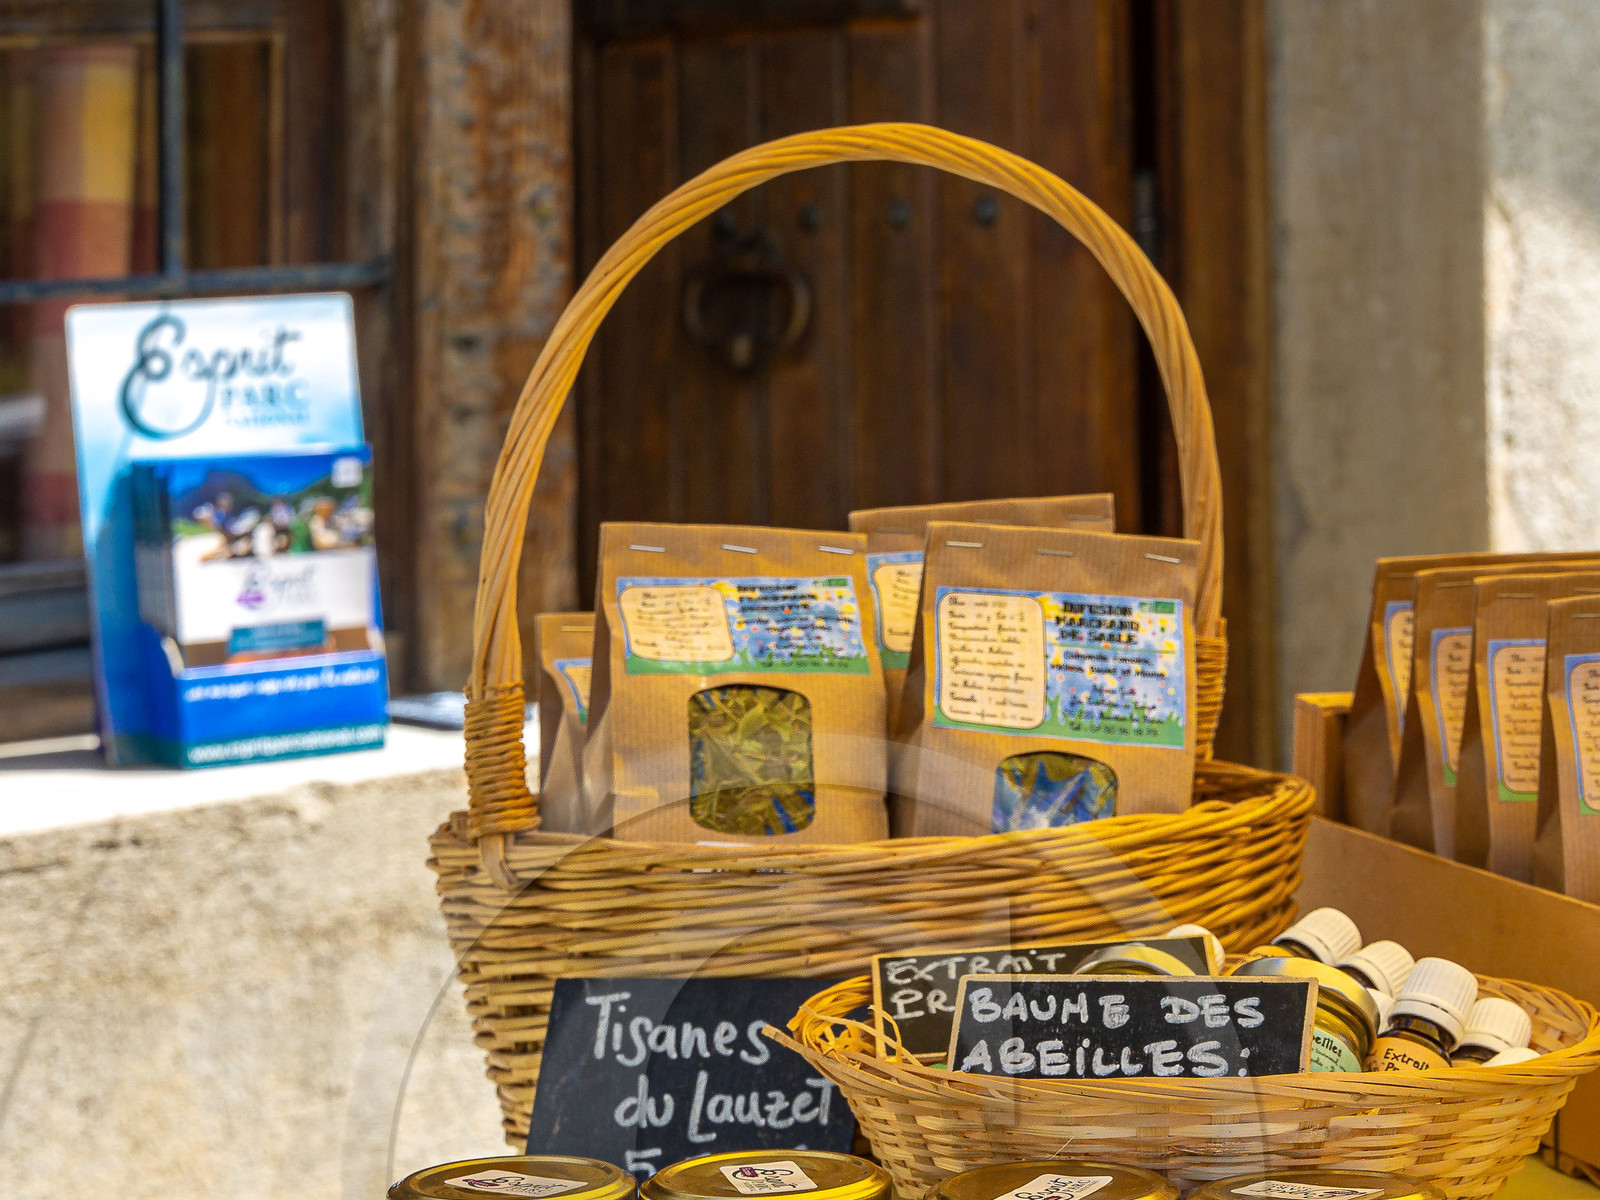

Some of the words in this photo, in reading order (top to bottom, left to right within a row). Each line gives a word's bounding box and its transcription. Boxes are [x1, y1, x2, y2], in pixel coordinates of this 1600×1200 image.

[117, 313, 302, 439] Esprit
[968, 987, 1130, 1029] BAUME
[1160, 993, 1266, 1029] DES
[1383, 1048, 1430, 1071] Extrait
[614, 1074, 675, 1130] du
